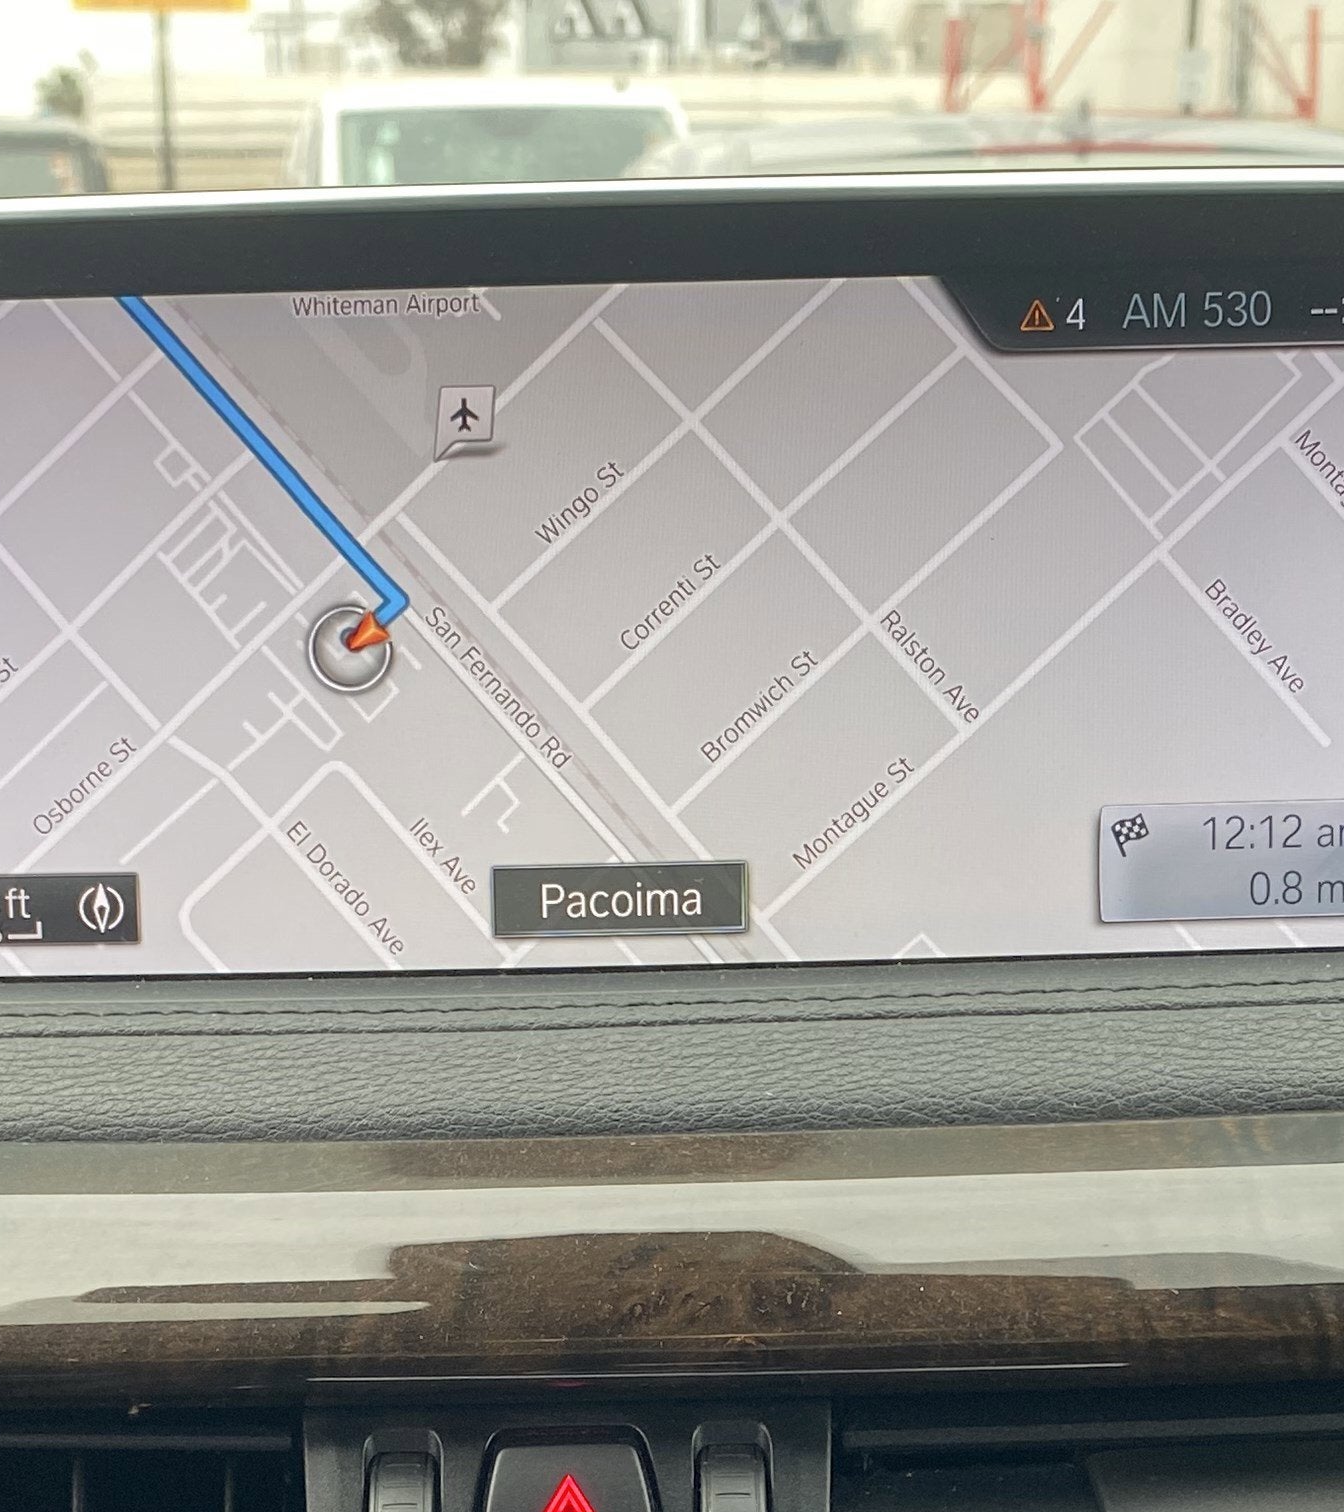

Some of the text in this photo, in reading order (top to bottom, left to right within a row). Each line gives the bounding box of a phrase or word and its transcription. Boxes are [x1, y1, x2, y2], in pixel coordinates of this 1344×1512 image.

[292, 293, 480, 317] Whiteman Airport
[1066, 298, 1086, 330] 4
[1122, 291, 1272, 329] AM 530
[534, 460, 625, 544] Wingo St
[620, 552, 722, 651] Correnti St
[1205, 579, 1306, 694] Bradley Ave
[424, 606, 573, 771] San Fernando Rd
[701, 649, 819, 763] Bromwich St
[881, 610, 980, 724] Ralston Ave
[33, 736, 137, 836] Osborne St
[792, 756, 915, 872] Montague St
[409, 817, 476, 895] Ilex Ave
[1203, 814, 1303, 850] 12:12
[5, 886, 31, 920] ft
[286, 821, 405, 956] El Dorado Ave
[540, 882, 703, 920] Pacoima
[1250, 871, 1303, 905] 0.8
